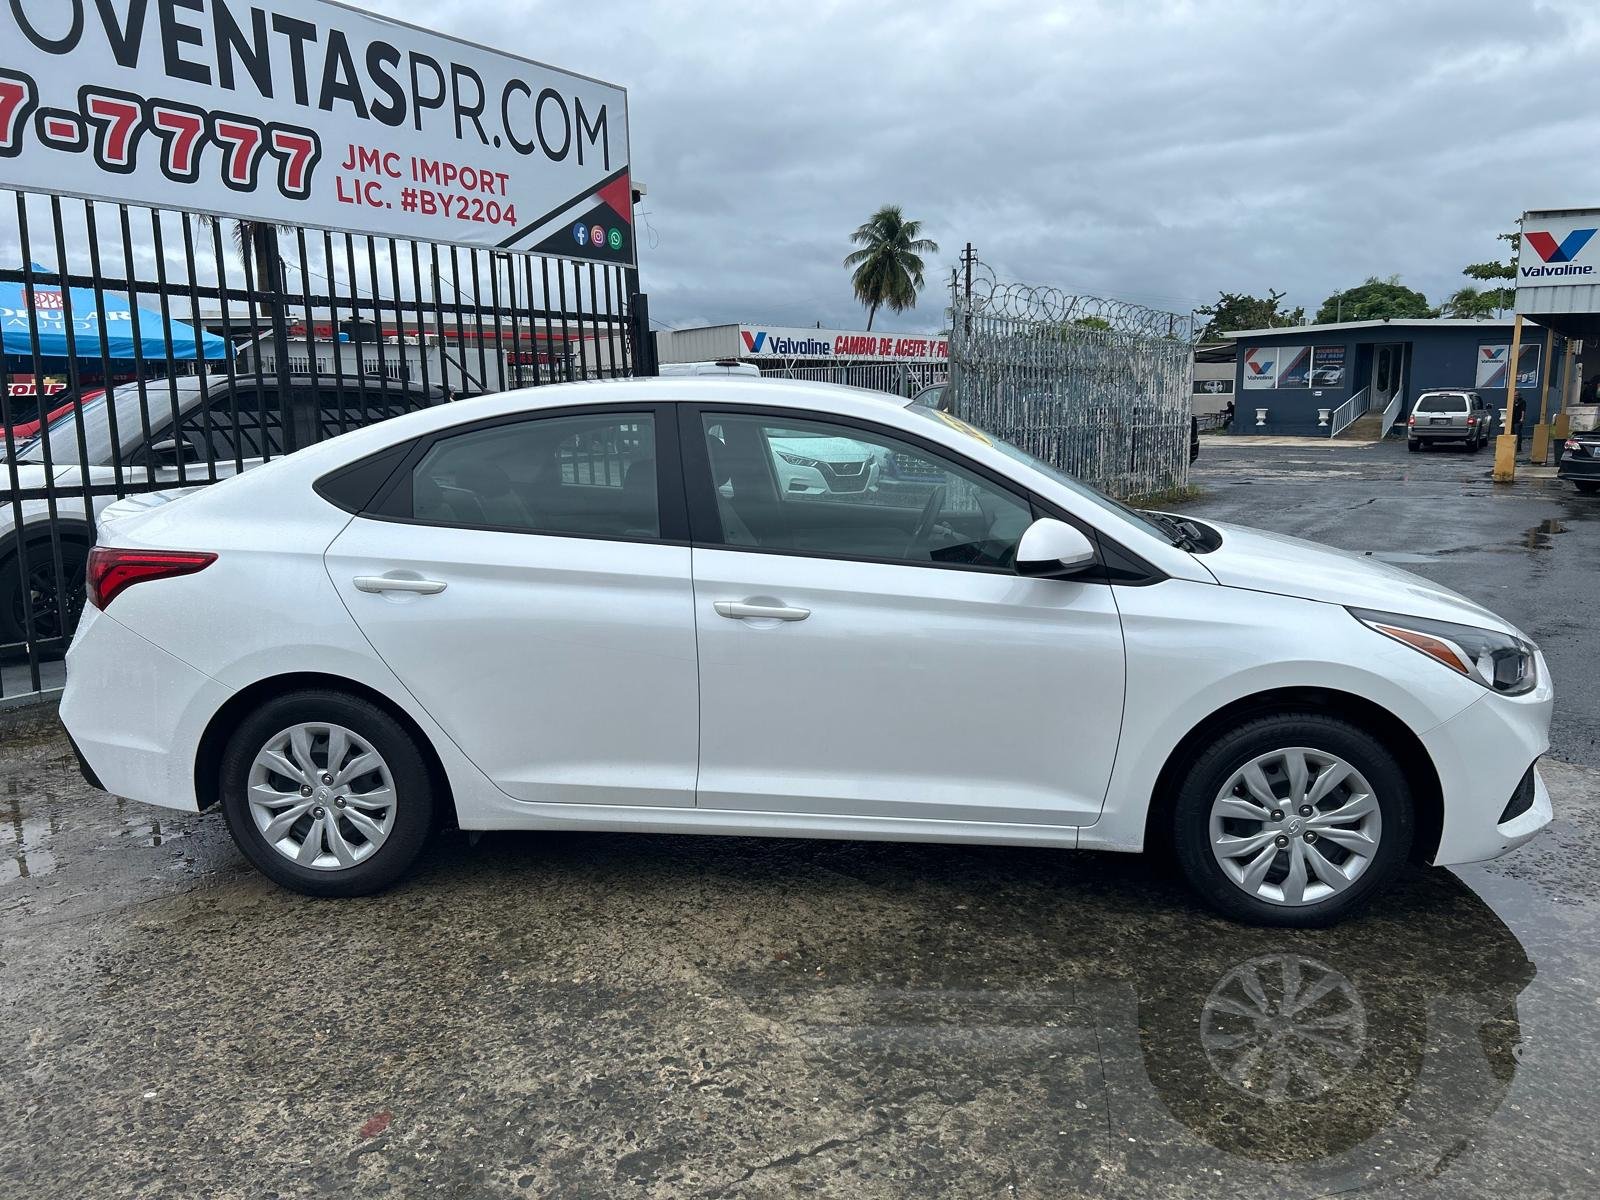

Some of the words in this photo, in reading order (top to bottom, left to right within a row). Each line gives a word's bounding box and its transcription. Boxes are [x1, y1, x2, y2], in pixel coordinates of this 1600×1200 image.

[342, 144, 402, 178] JMC
[411, 157, 510, 196] IMPORT
[335, 176, 392, 209] LIC.
[401, 187, 517, 227] #BY2204
[1521, 264, 1592, 277] Valvoline
[768, 337, 830, 355] Valvoline
[834, 336, 876, 355] CAMBIO
[879, 338, 893, 355] DE
[895, 339, 927, 357] ACEITE
[929, 341, 936, 357] Y
